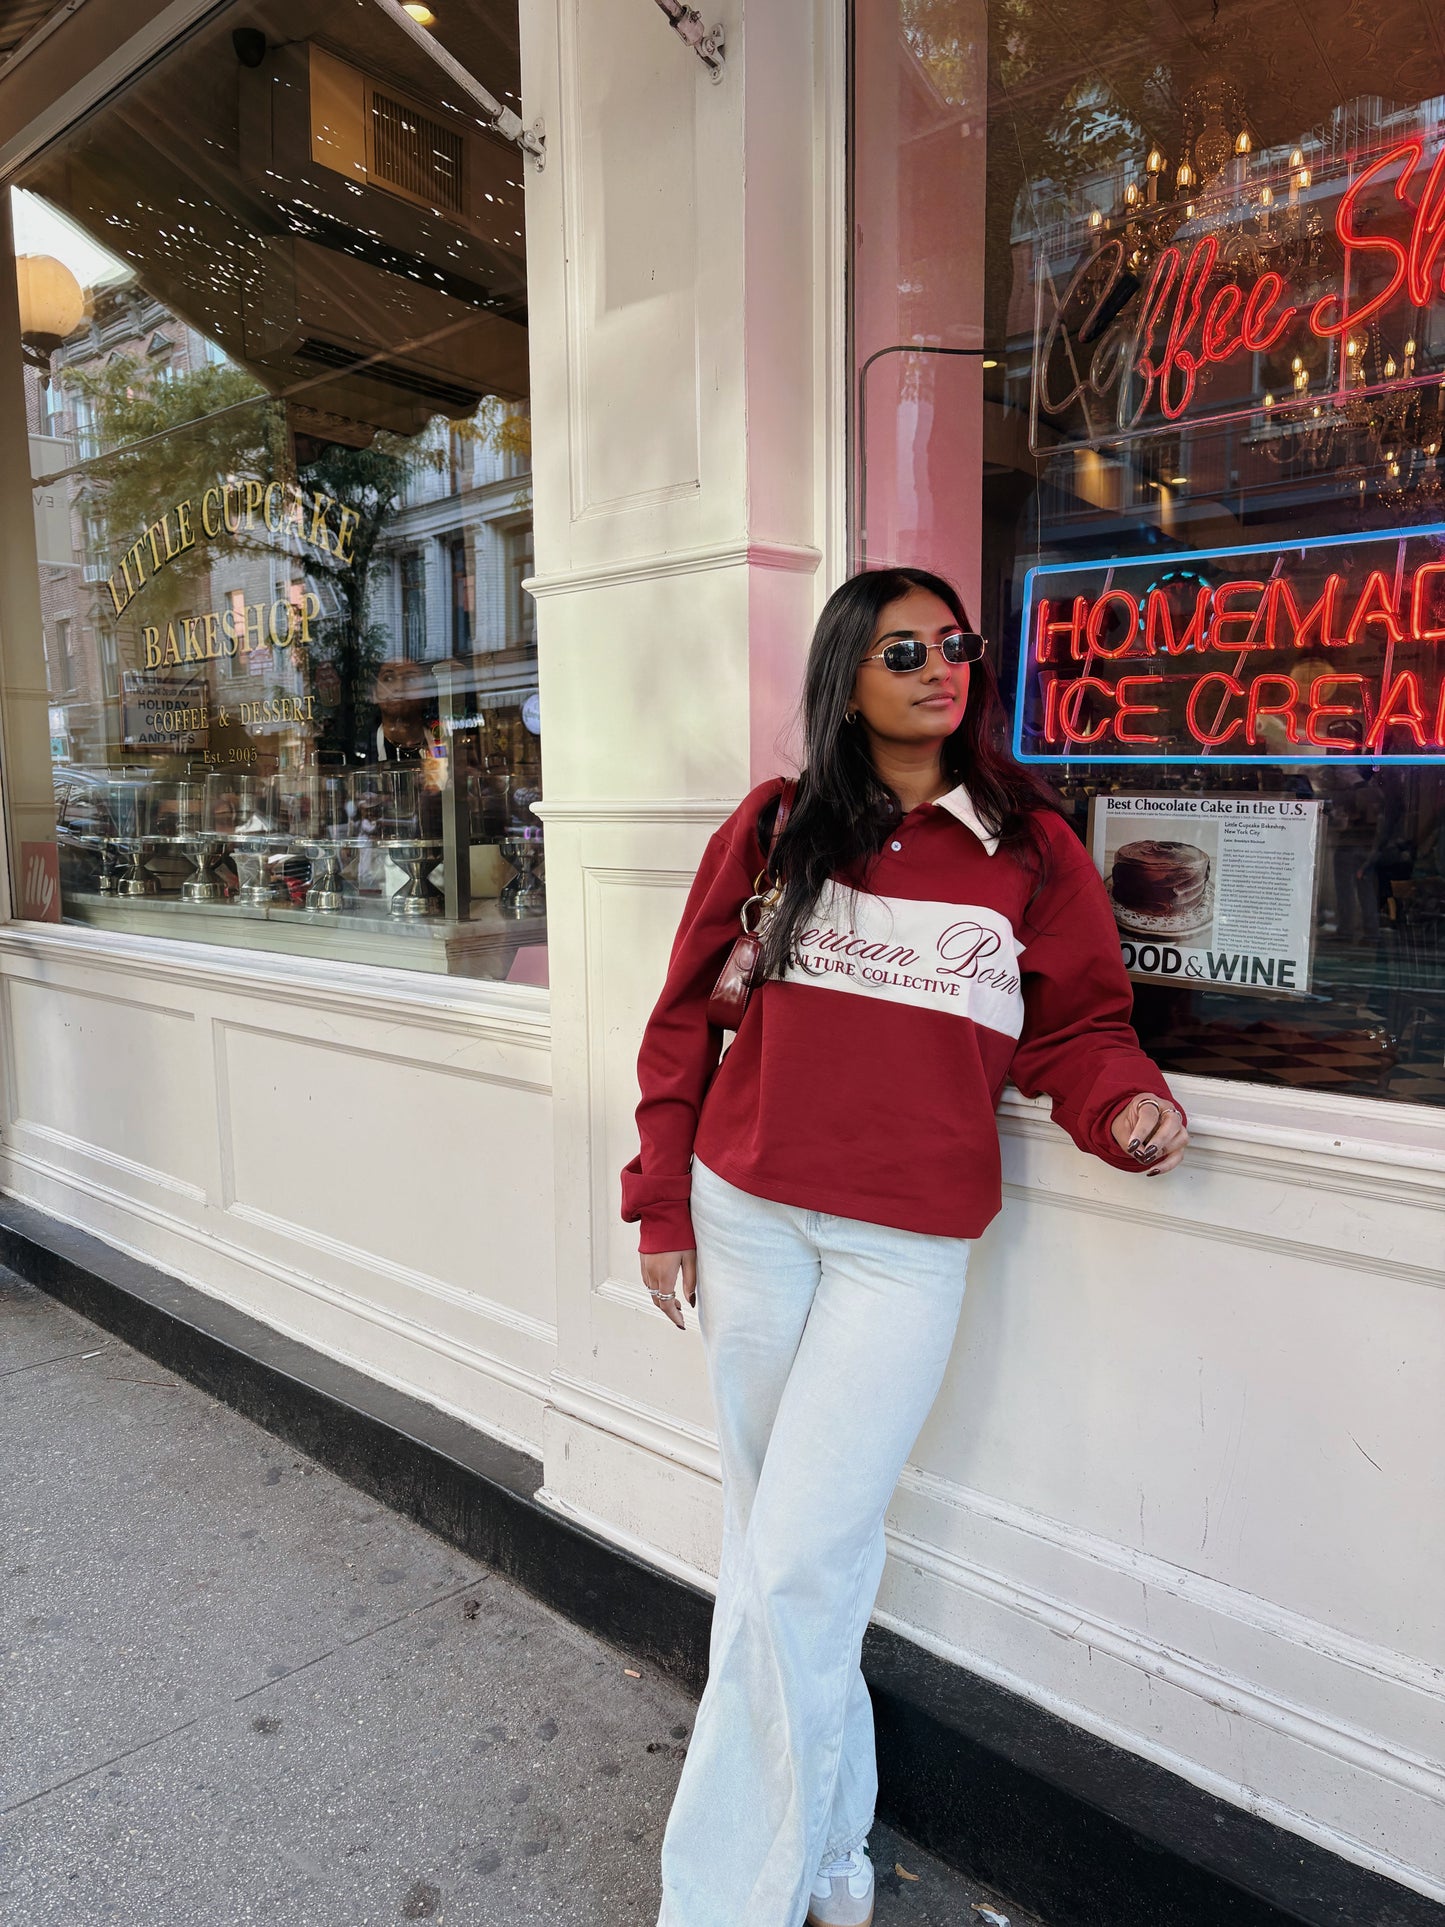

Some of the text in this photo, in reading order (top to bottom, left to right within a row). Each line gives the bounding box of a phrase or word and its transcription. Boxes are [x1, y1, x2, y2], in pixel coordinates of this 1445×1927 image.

[1041, 235, 1297, 432] Coffee
[107, 480, 360, 619] LITTLE CUPCAKE
[143, 592, 320, 669] BAKESHOP
[138, 699, 190, 711] HOLIDAY
[153, 695, 315, 733] COFFEE & DESSERT
[1045, 669, 1445, 750] ICE CREA
[138, 733, 166, 745] AND
[203, 748, 258, 764] Est. 2005
[1107, 798, 1131, 810] Best
[1135, 799, 1197, 812] Chocolate
[1200, 801, 1232, 814] Cake
[1236, 801, 1251, 813] in
[1253, 802, 1275, 815] the
[1279, 803, 1307, 816] U.S.
[25, 854, 54, 918] illy
[799, 921, 1020, 995] erican Born
[862, 966, 961, 996] COLLECTIVE
